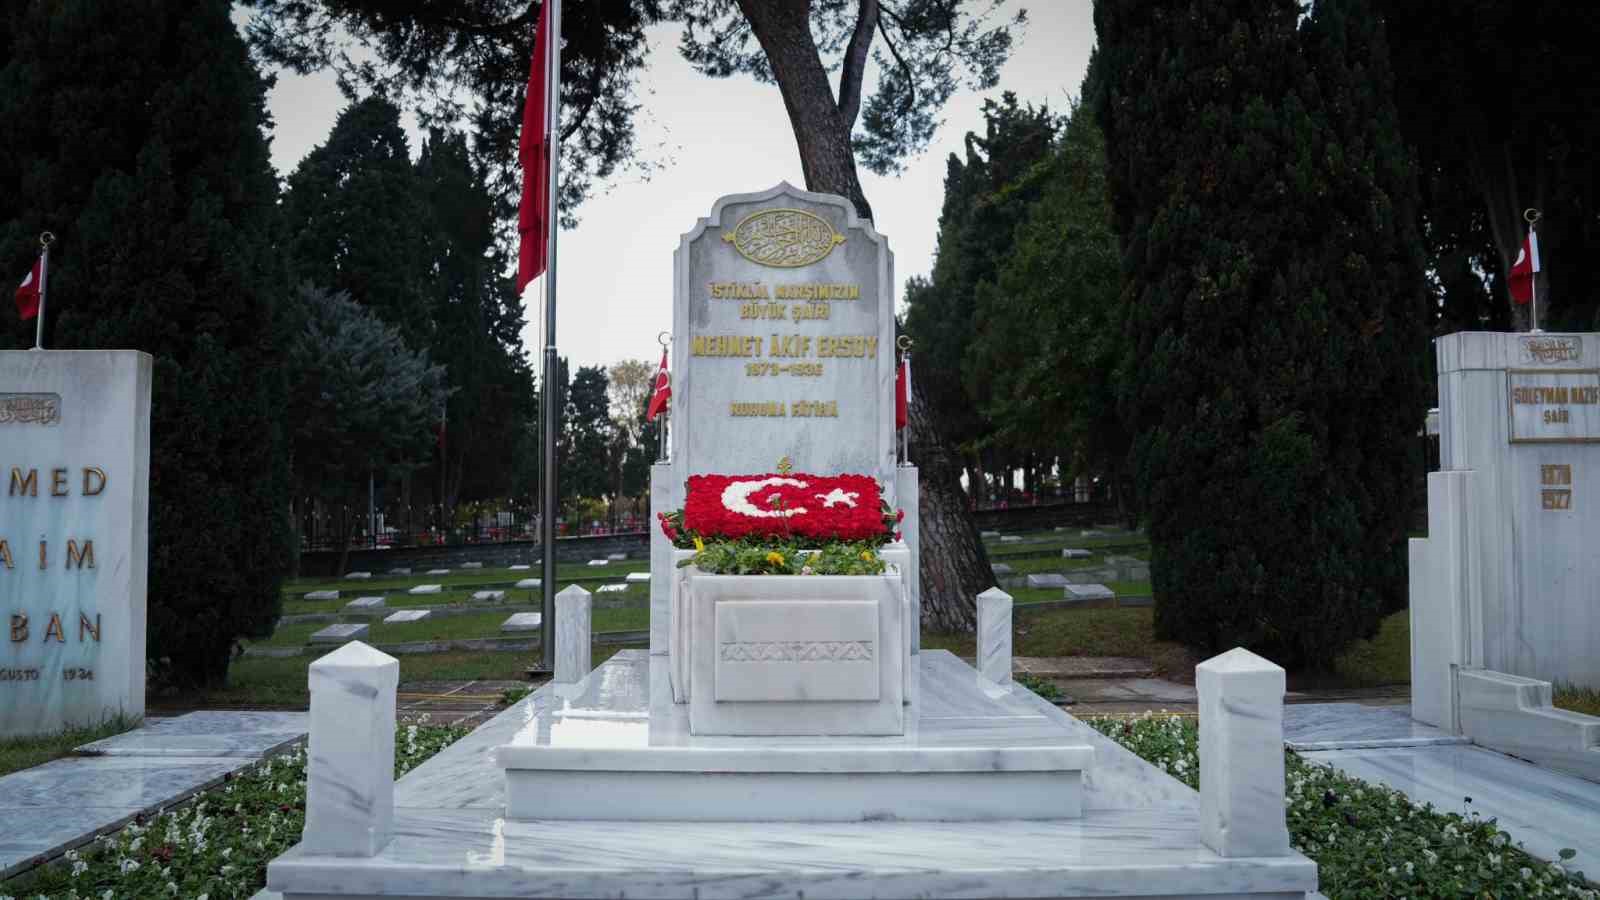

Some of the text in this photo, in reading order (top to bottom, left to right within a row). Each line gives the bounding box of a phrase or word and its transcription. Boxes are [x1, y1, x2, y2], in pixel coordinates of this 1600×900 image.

[739, 302, 786, 320] BÜYÜK
[691, 335, 763, 358] MEHMET
[816, 335, 879, 359] ERSOY
